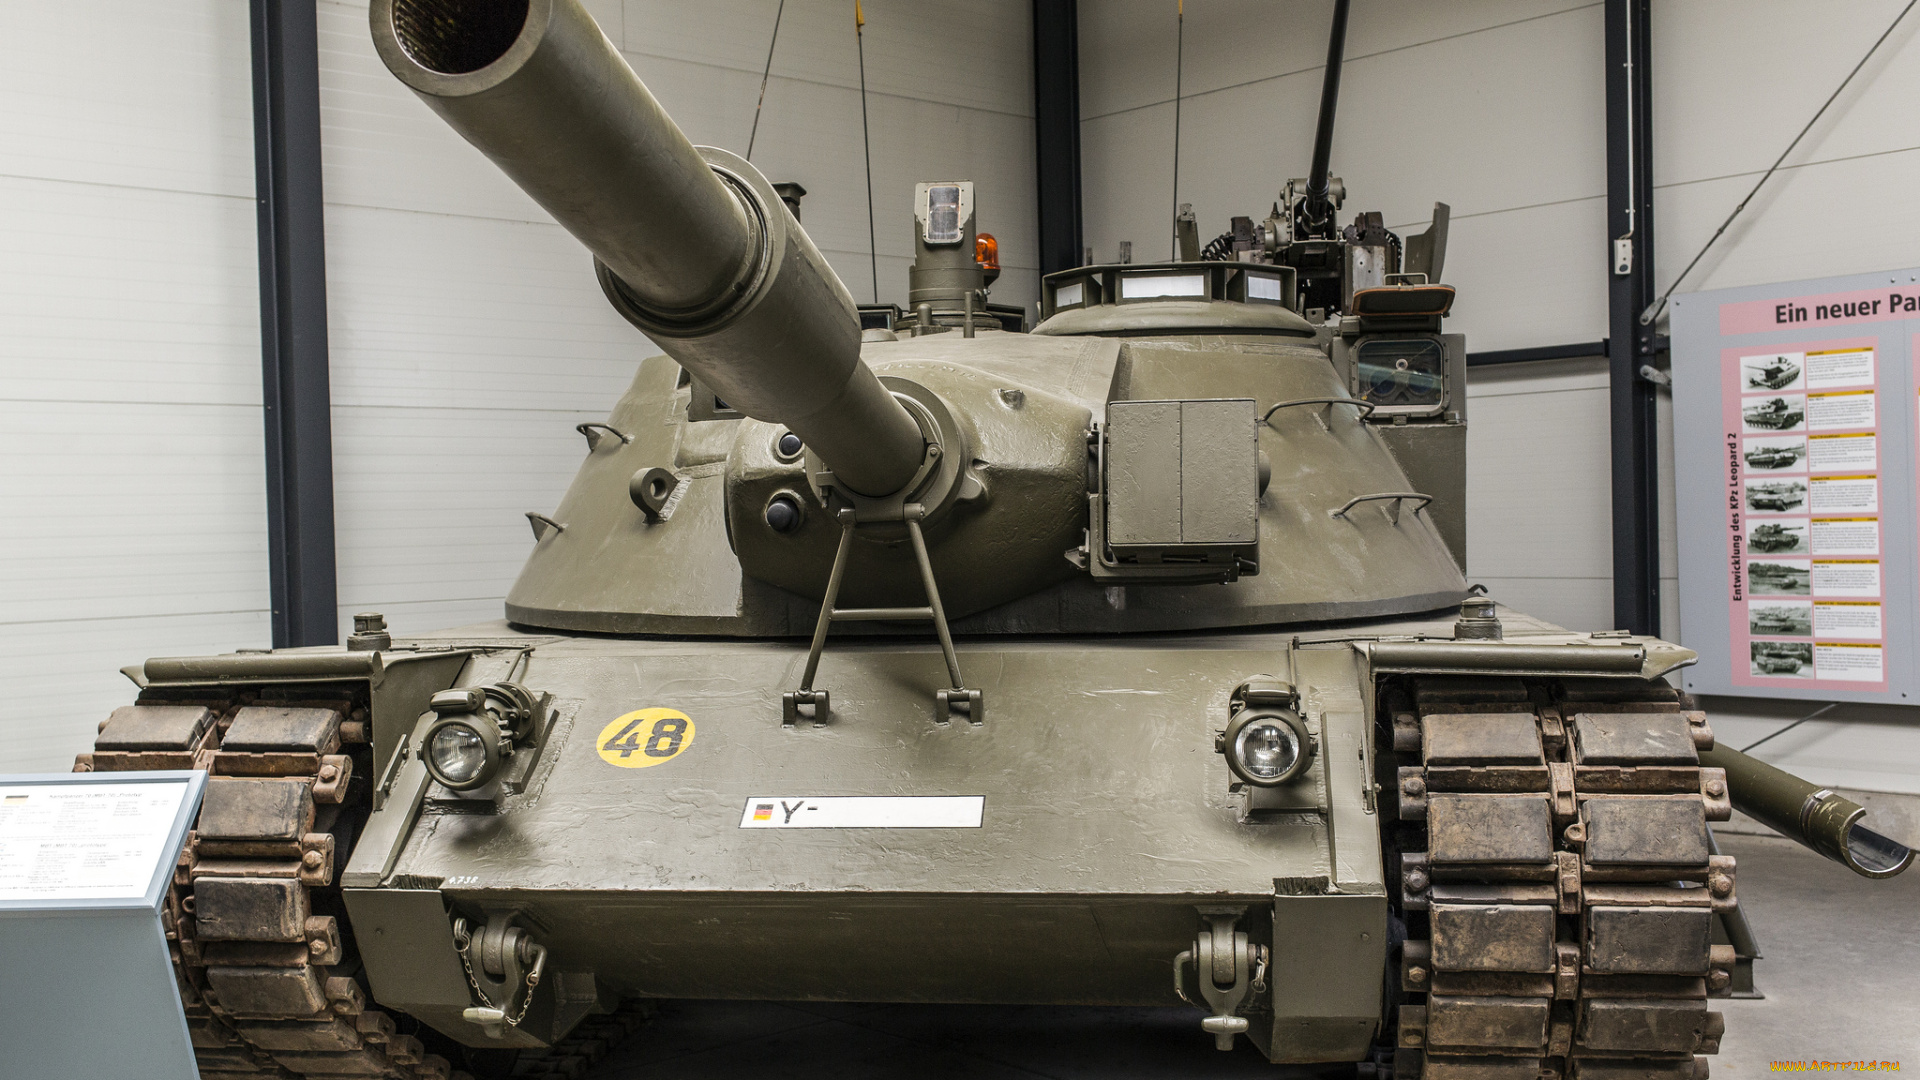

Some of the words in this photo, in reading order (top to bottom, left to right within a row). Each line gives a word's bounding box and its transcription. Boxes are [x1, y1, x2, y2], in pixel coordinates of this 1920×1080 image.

[1776, 303, 1807, 323] Ein
[1816, 300, 1881, 320] neuer
[1890, 294, 1920, 313] Pa
[1727, 443, 1740, 487] Leopard
[1730, 490, 1739, 509] KPz
[1730, 513, 1740, 531] des
[1731, 535, 1742, 601] Entwicklung
[602, 718, 688, 757] 48
